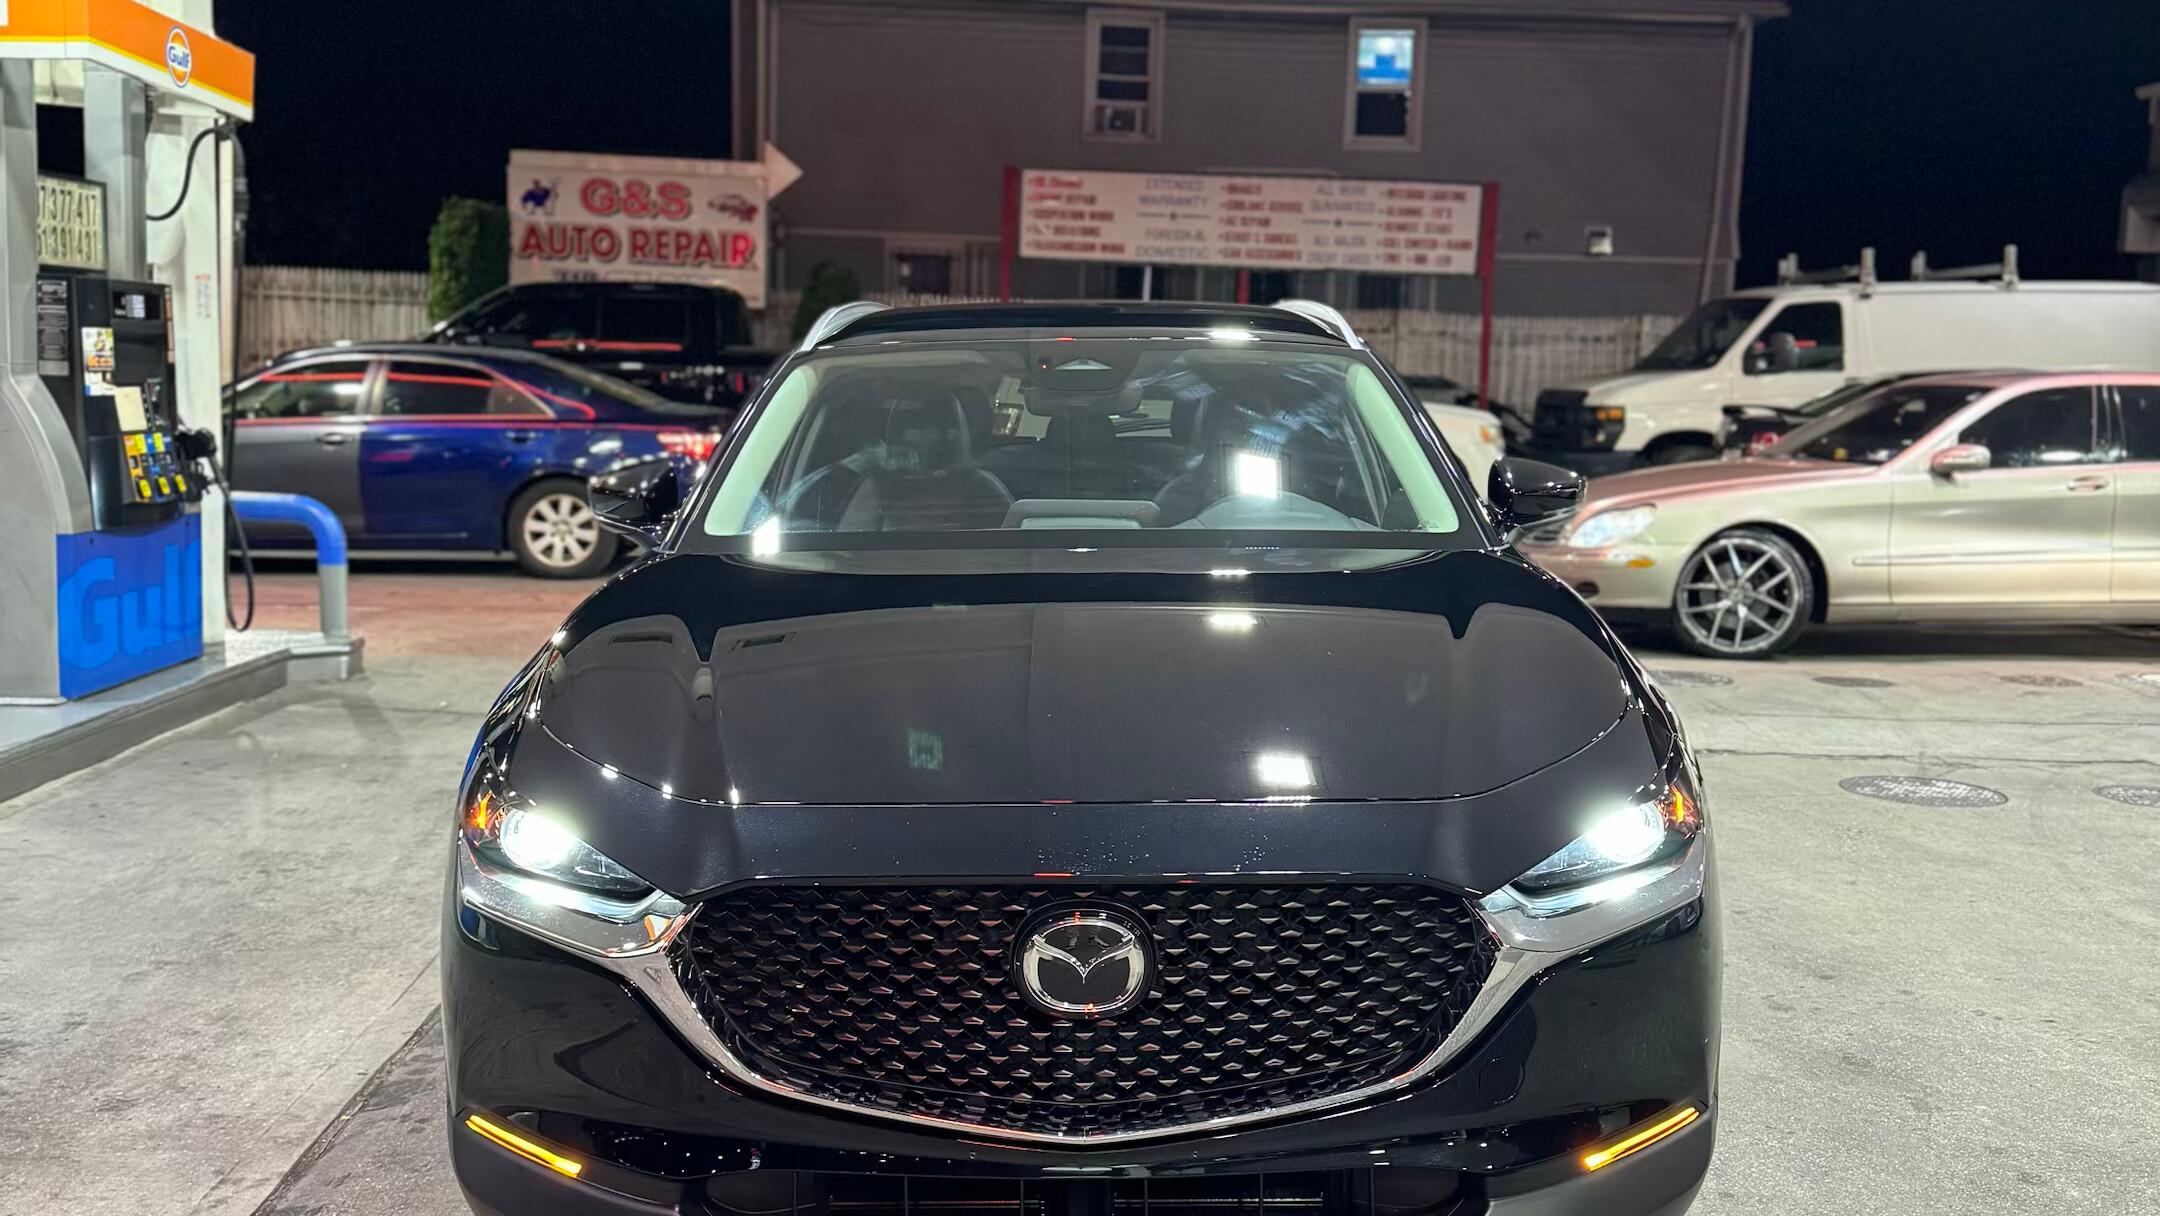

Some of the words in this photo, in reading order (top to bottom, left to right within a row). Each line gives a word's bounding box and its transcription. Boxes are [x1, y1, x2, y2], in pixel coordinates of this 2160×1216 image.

[168, 45, 189, 69] Gulf
[580, 178, 692, 220] G&S
[517, 224, 621, 263] AUTO
[628, 229, 757, 269] REPAIR
